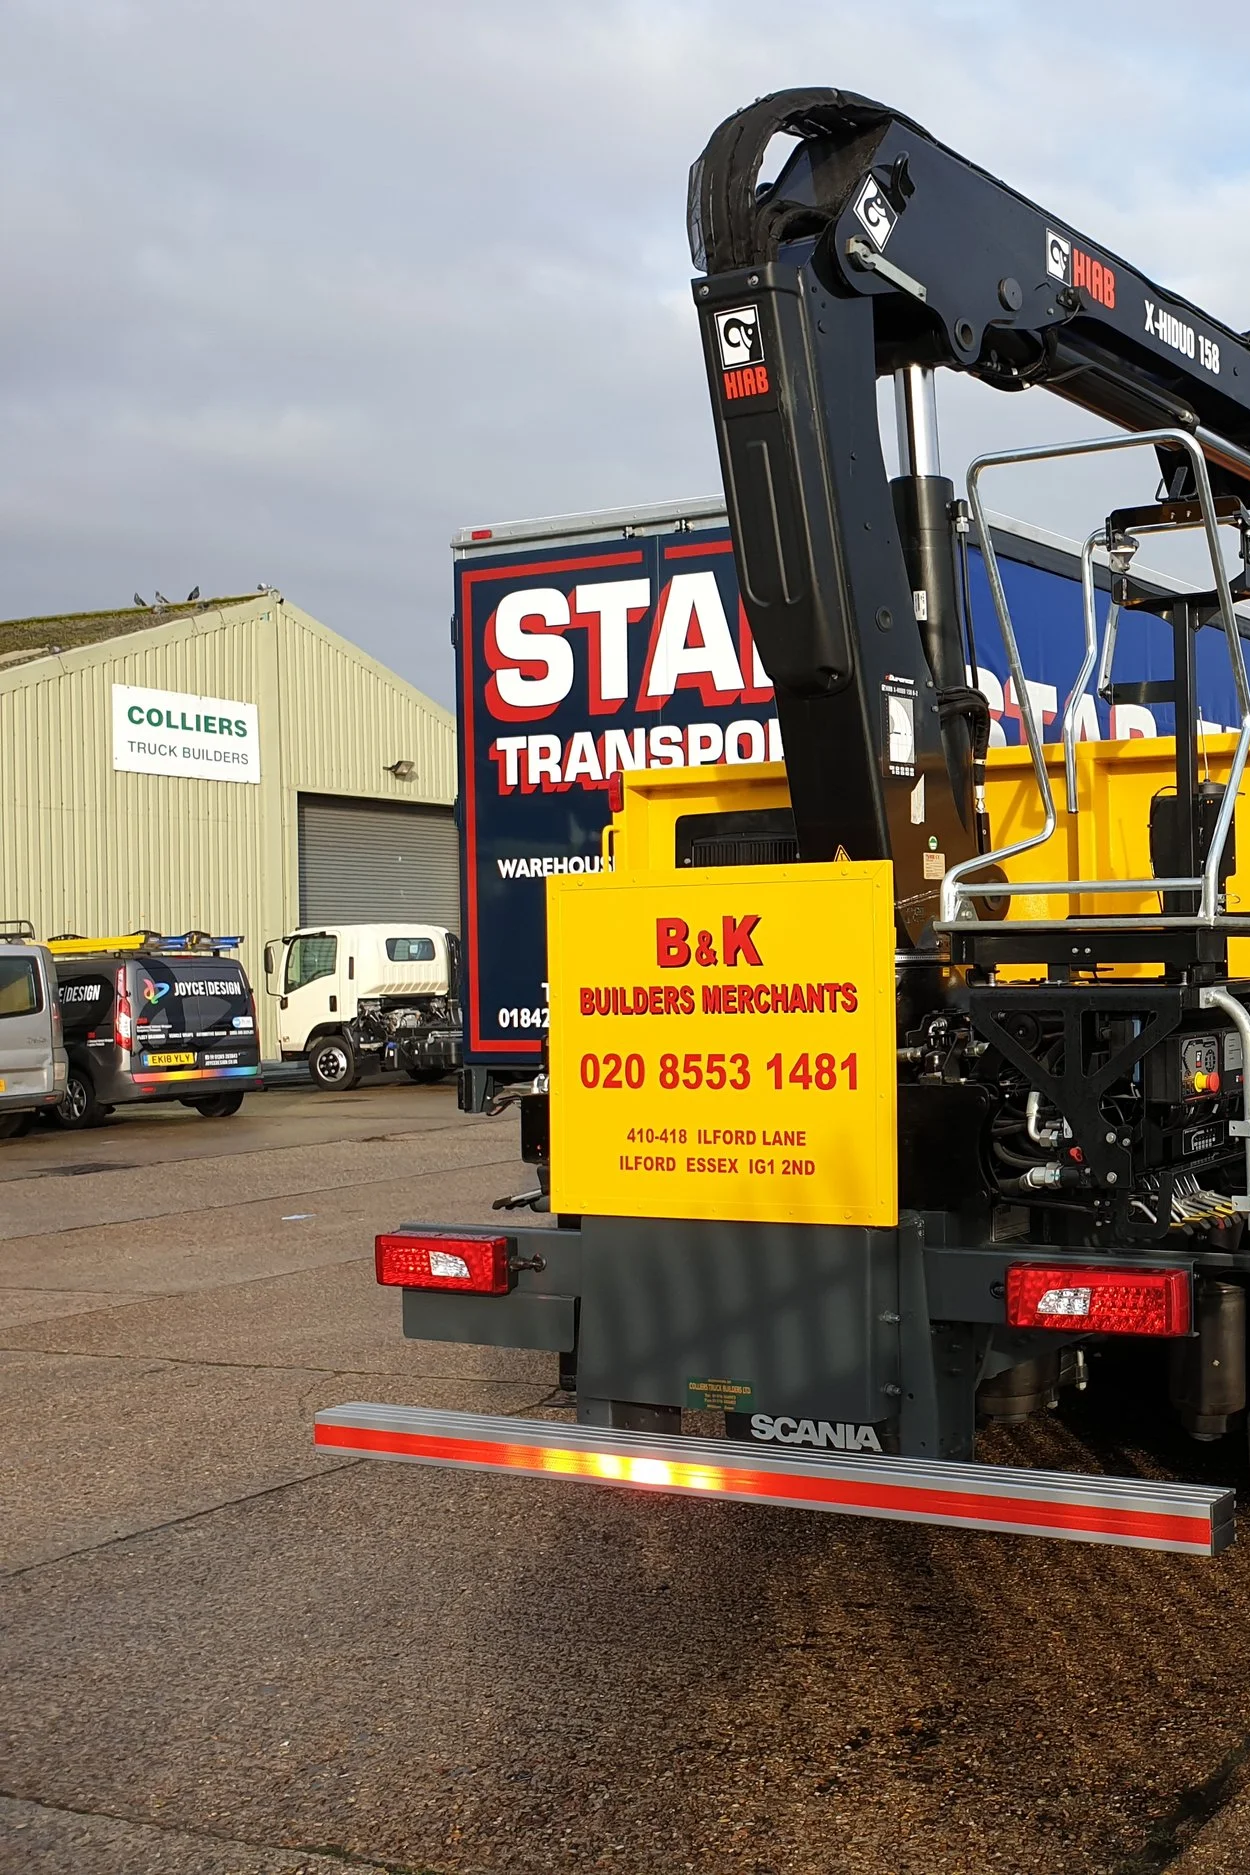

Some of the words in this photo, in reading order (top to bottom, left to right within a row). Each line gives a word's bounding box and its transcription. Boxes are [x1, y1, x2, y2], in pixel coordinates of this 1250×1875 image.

[1073, 248, 1115, 309] HIAB
[1144, 299, 1195, 360] X-HIDUO
[1198, 335, 1220, 375] 158
[723, 365, 769, 400] HIAB
[490, 570, 774, 714] STA
[127, 705, 247, 738] COLLIERS
[127, 740, 178, 758] TRUCK
[182, 746, 249, 765] BUILDERS
[579, 984, 695, 1016] BUILDERS
[701, 982, 859, 1015] MERCHANTS
[151, 1054, 172, 1065] EK18
[174, 1054, 190, 1063] YLY
[580, 1052, 646, 1090] 020
[658, 1052, 751, 1090] 8553
[765, 1052, 859, 1091] 1481
[626, 1127, 688, 1145] 410-418
[697, 1128, 757, 1146] ILFORD
[762, 1130, 807, 1147] LANE
[619, 1155, 677, 1172] ILFORD
[686, 1156, 739, 1174] ESSEX
[748, 1158, 776, 1175] IG1
[781, 1159, 816, 1176] 2ND
[750, 1413, 883, 1452] SCANIA
